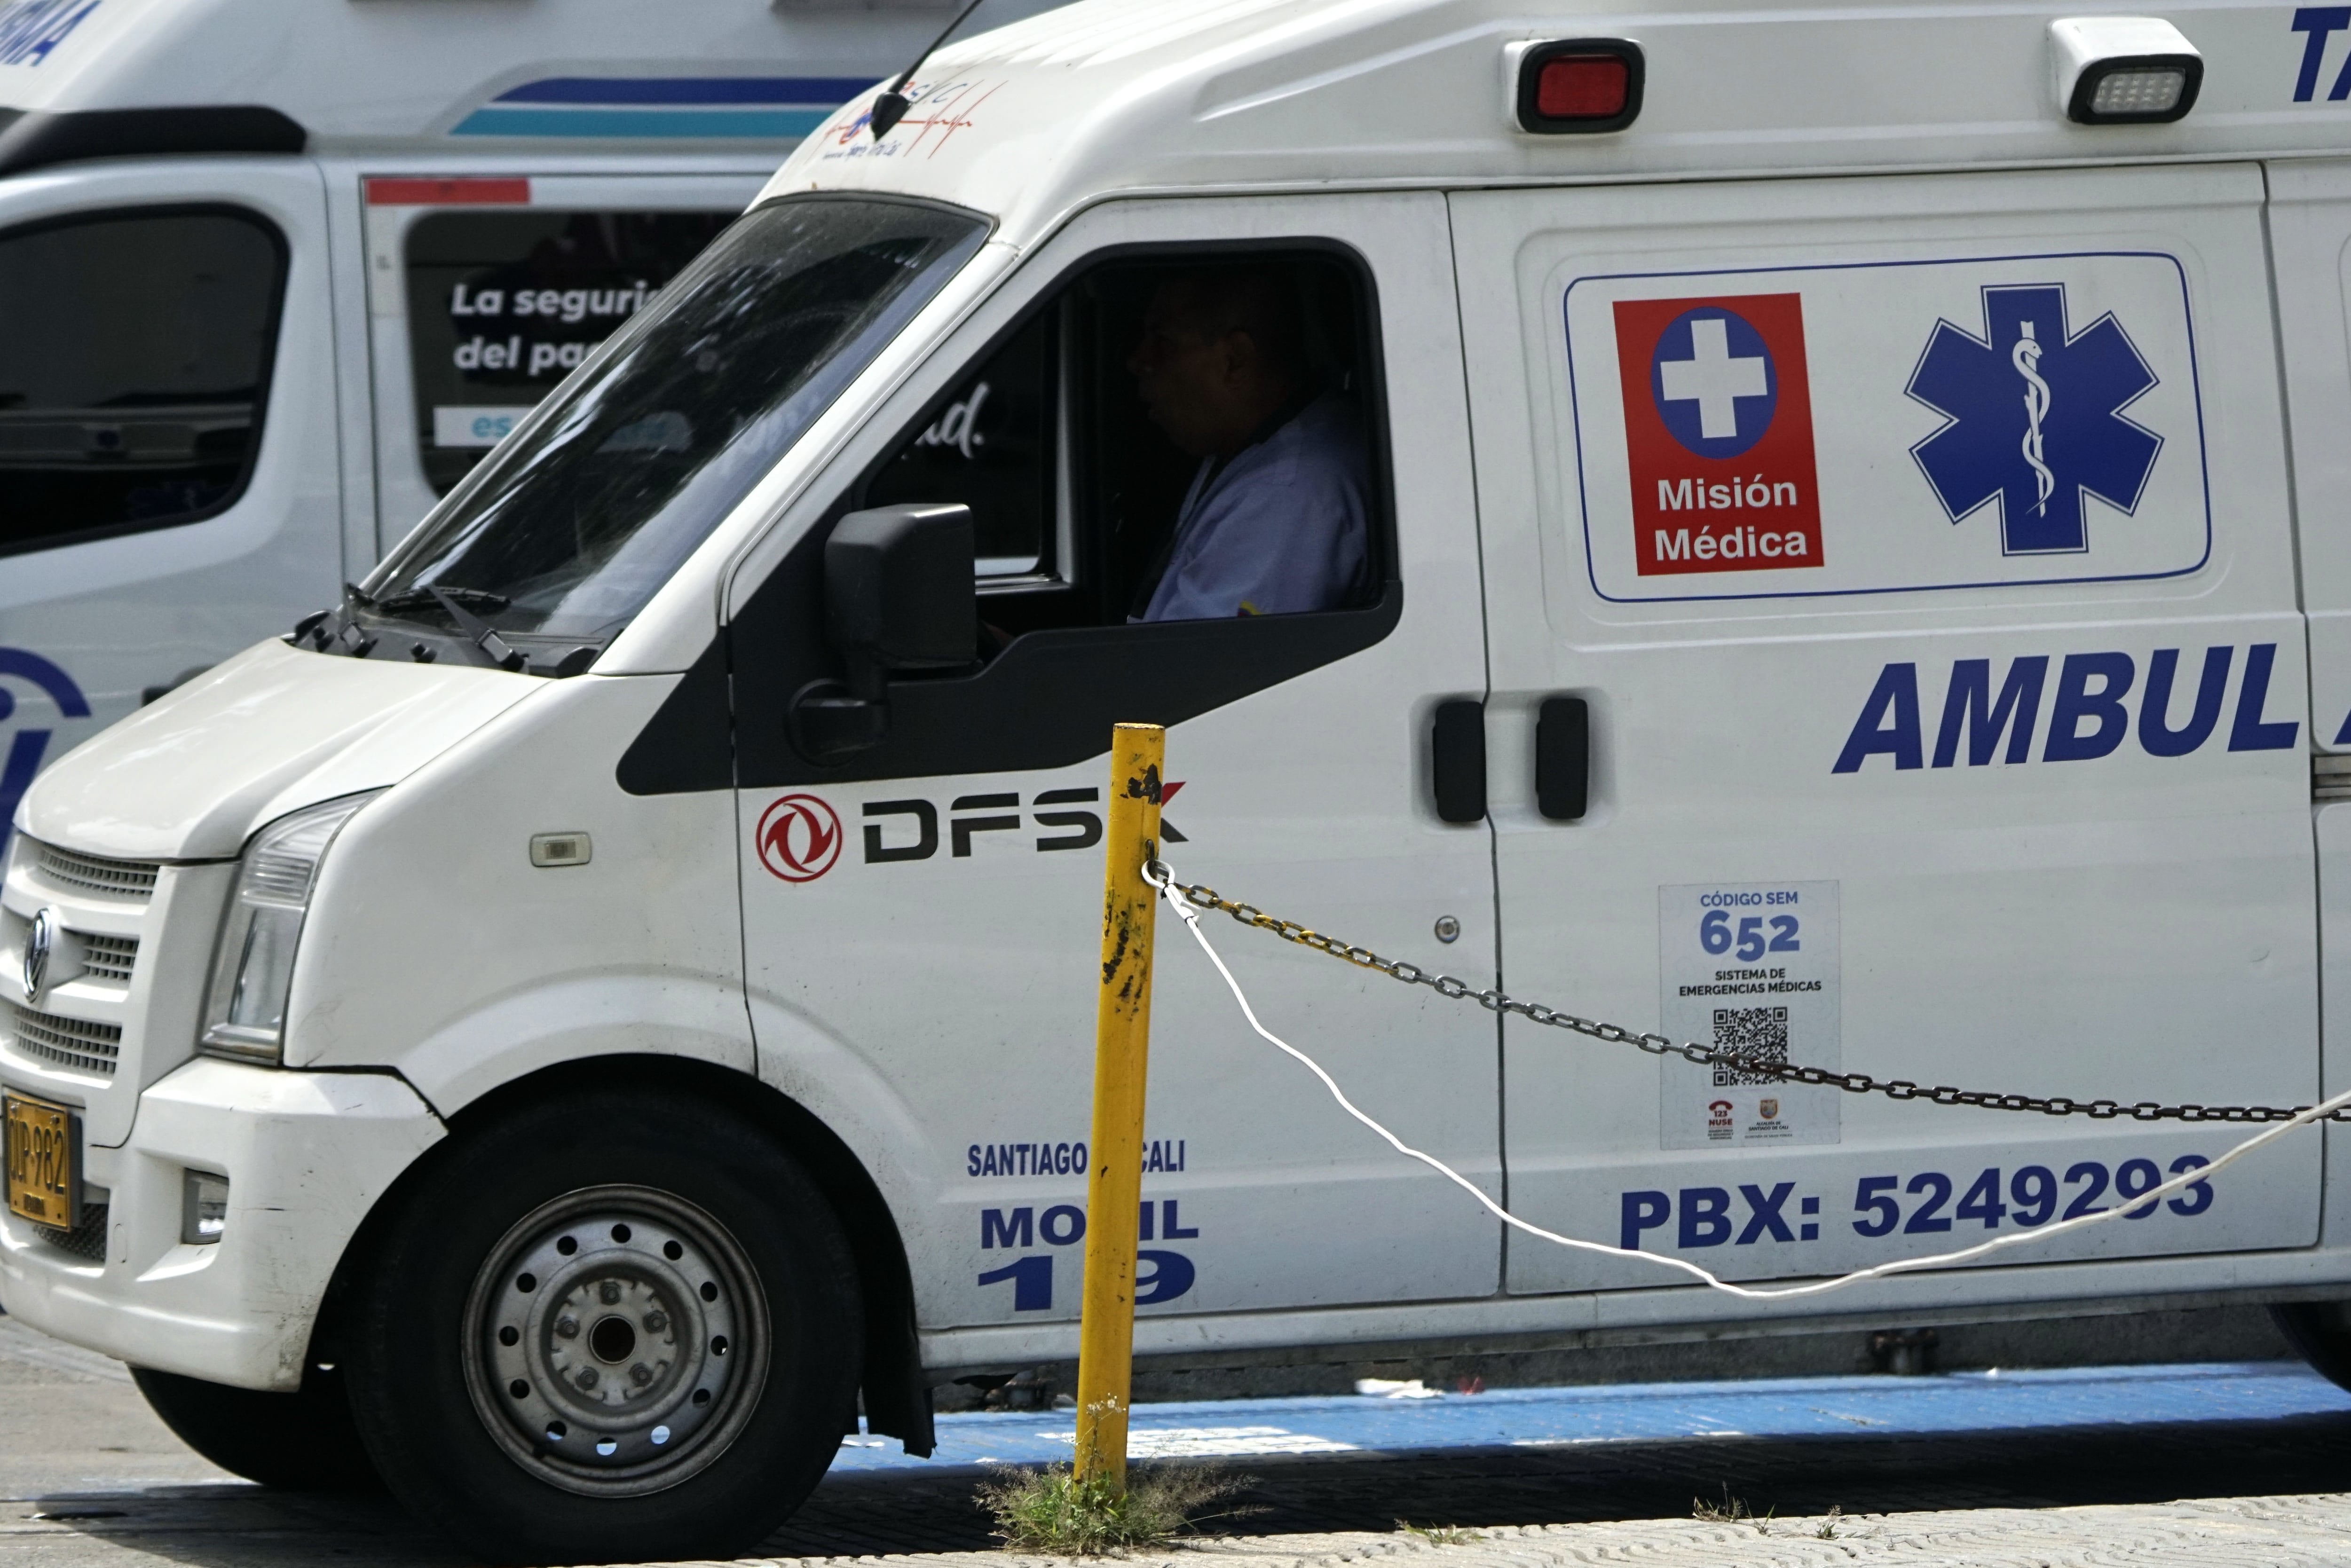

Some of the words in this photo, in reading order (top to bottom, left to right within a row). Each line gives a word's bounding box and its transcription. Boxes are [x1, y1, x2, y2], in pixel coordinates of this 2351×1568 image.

[450, 283, 505, 315] La
[512, 280, 662, 323] seguri
[453, 336, 521, 370] del
[528, 343, 590, 376] pa
[1657, 473, 1798, 512] Misión
[1655, 525, 1807, 561] Médica
[1831, 643, 2351, 774] AMBUL
[1700, 890, 1762, 907] CÓDIGO
[1766, 891, 1798, 904] SEM
[1700, 909, 1800, 962] 652
[1679, 983, 1765, 997] EMERGENCIAS
[1768, 979, 1822, 993] MÉDICAS
[1715, 969, 1767, 981] SISTEMA
[1769, 968, 1786, 979] DE
[967, 1142, 1088, 1176] SANTIAGO
[1619, 1181, 1821, 1251] PBX:
[1851, 1155, 2215, 1238] 5249293
[981, 1200, 1199, 1249] MOIL
